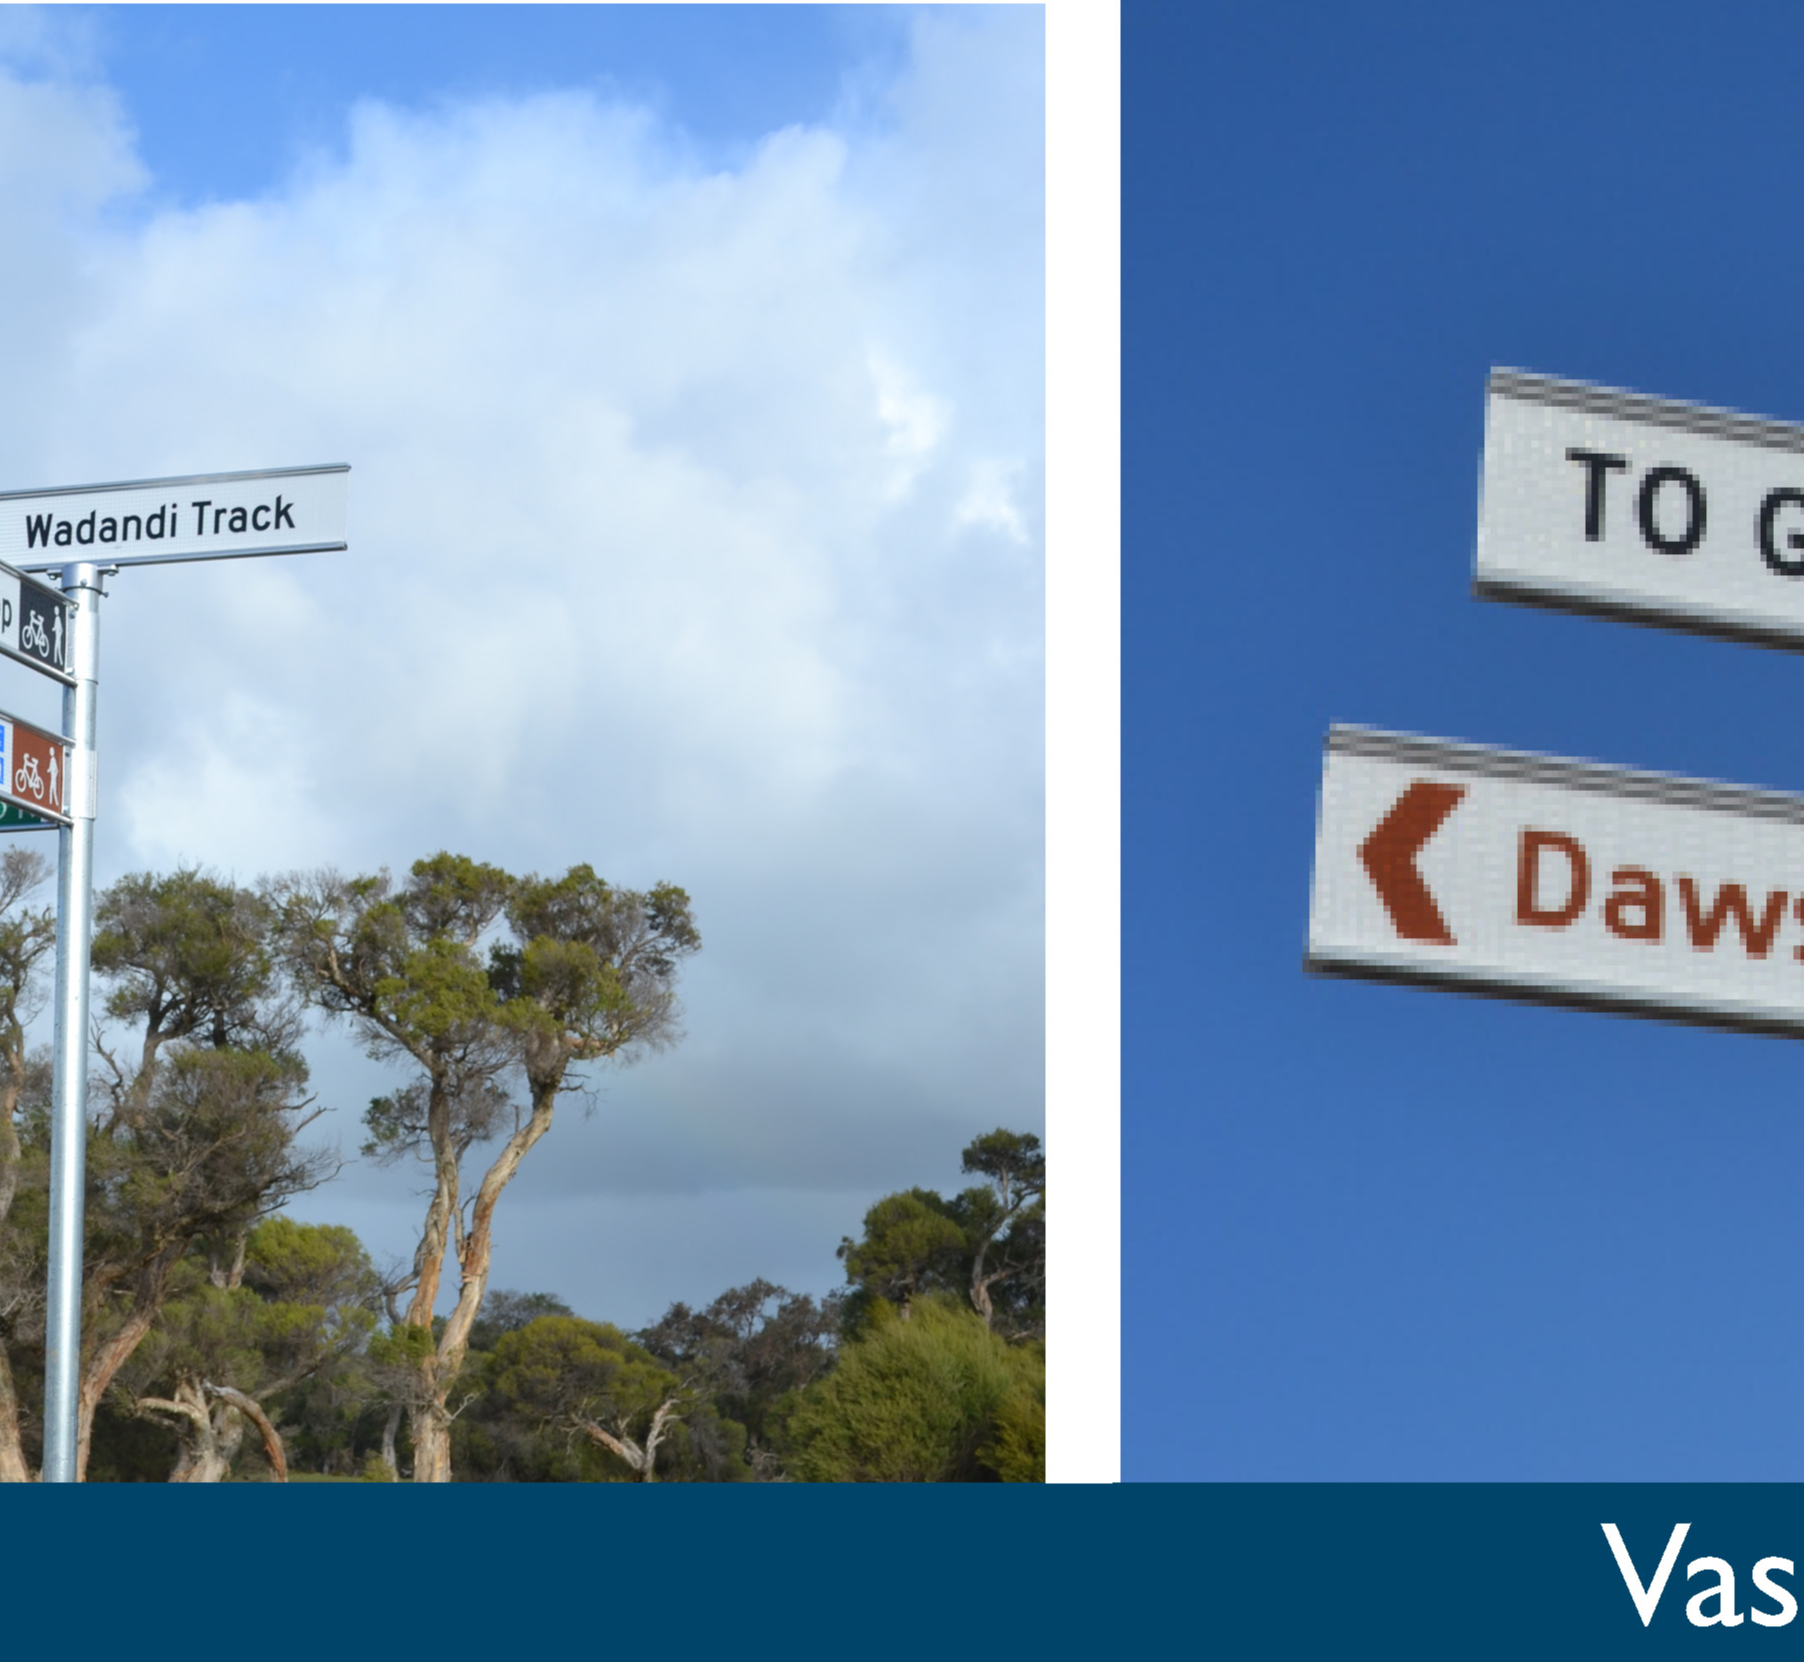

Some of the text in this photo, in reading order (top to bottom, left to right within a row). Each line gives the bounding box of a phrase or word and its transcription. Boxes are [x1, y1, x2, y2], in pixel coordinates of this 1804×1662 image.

[25, 494, 297, 549] Wadandi Track
[1564, 446, 1708, 556] TO
